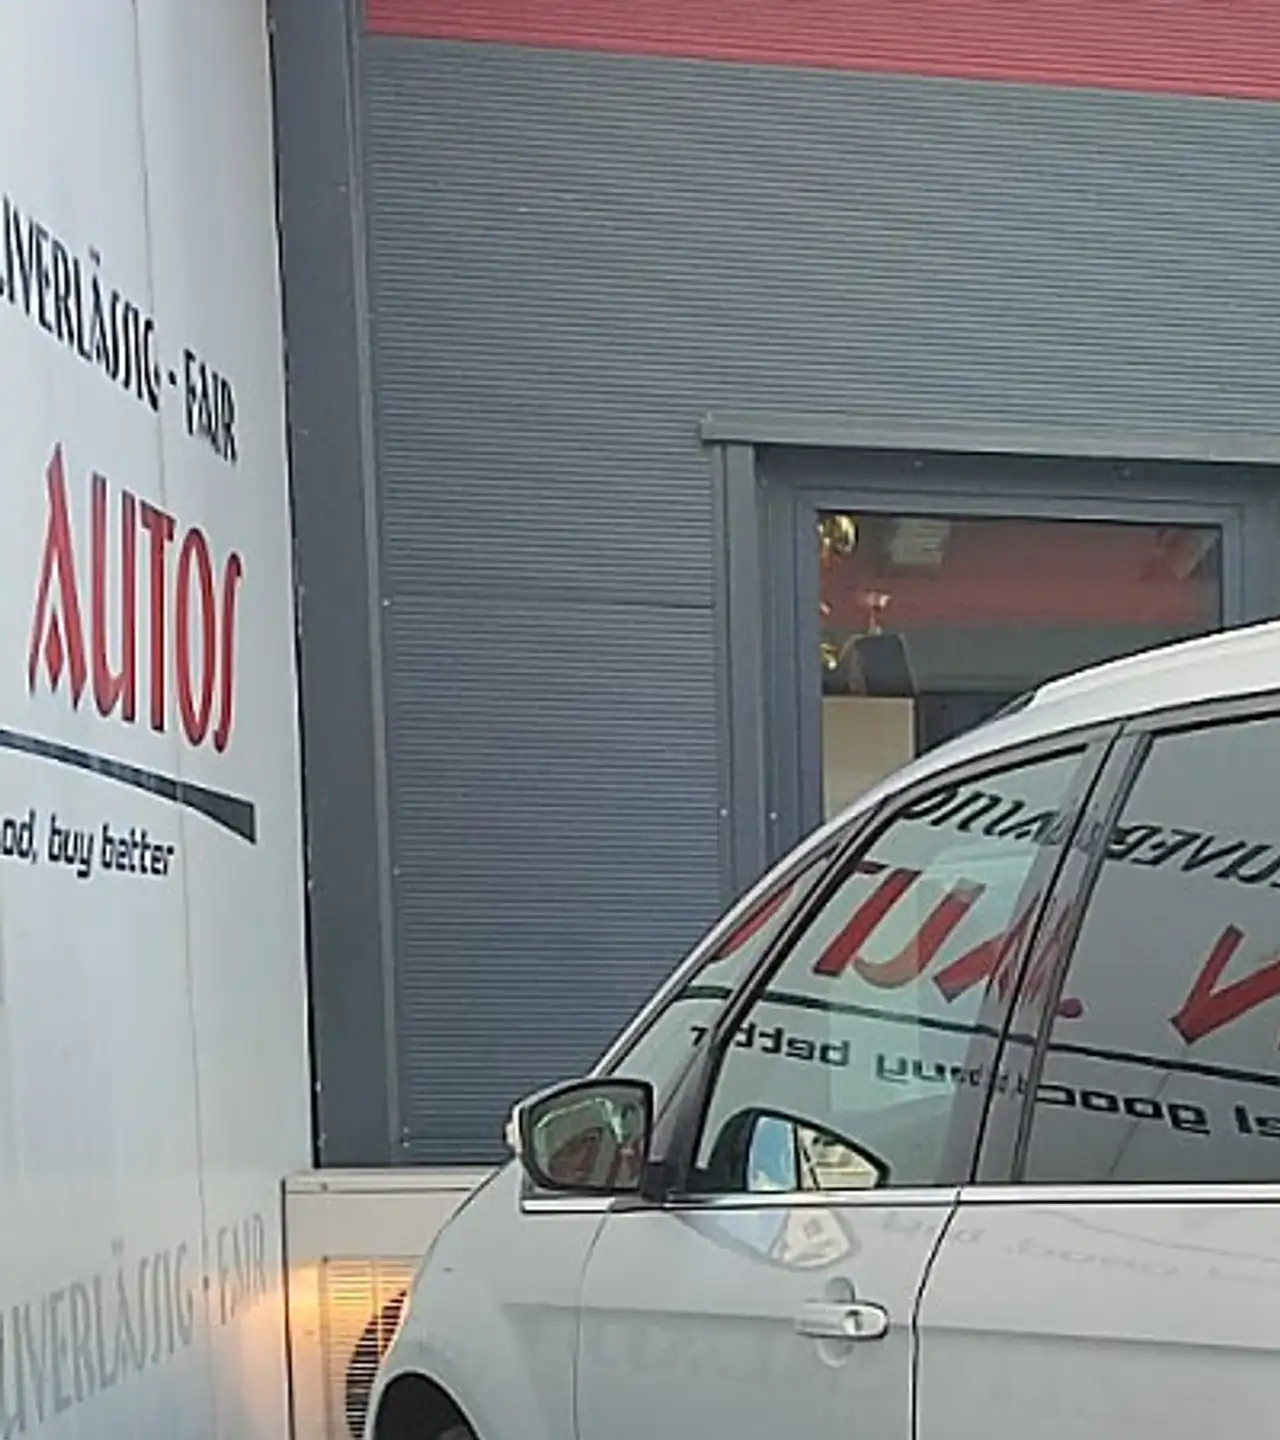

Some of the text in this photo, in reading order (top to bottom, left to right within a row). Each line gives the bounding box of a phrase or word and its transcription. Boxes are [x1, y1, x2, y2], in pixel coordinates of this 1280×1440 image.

[184, 347, 237, 463] FAIR
[28, 440, 243, 754] AUTOS
[49, 813, 94, 878] buy
[102, 822, 175, 876] better
[217, 1213, 267, 1326] FAIR
